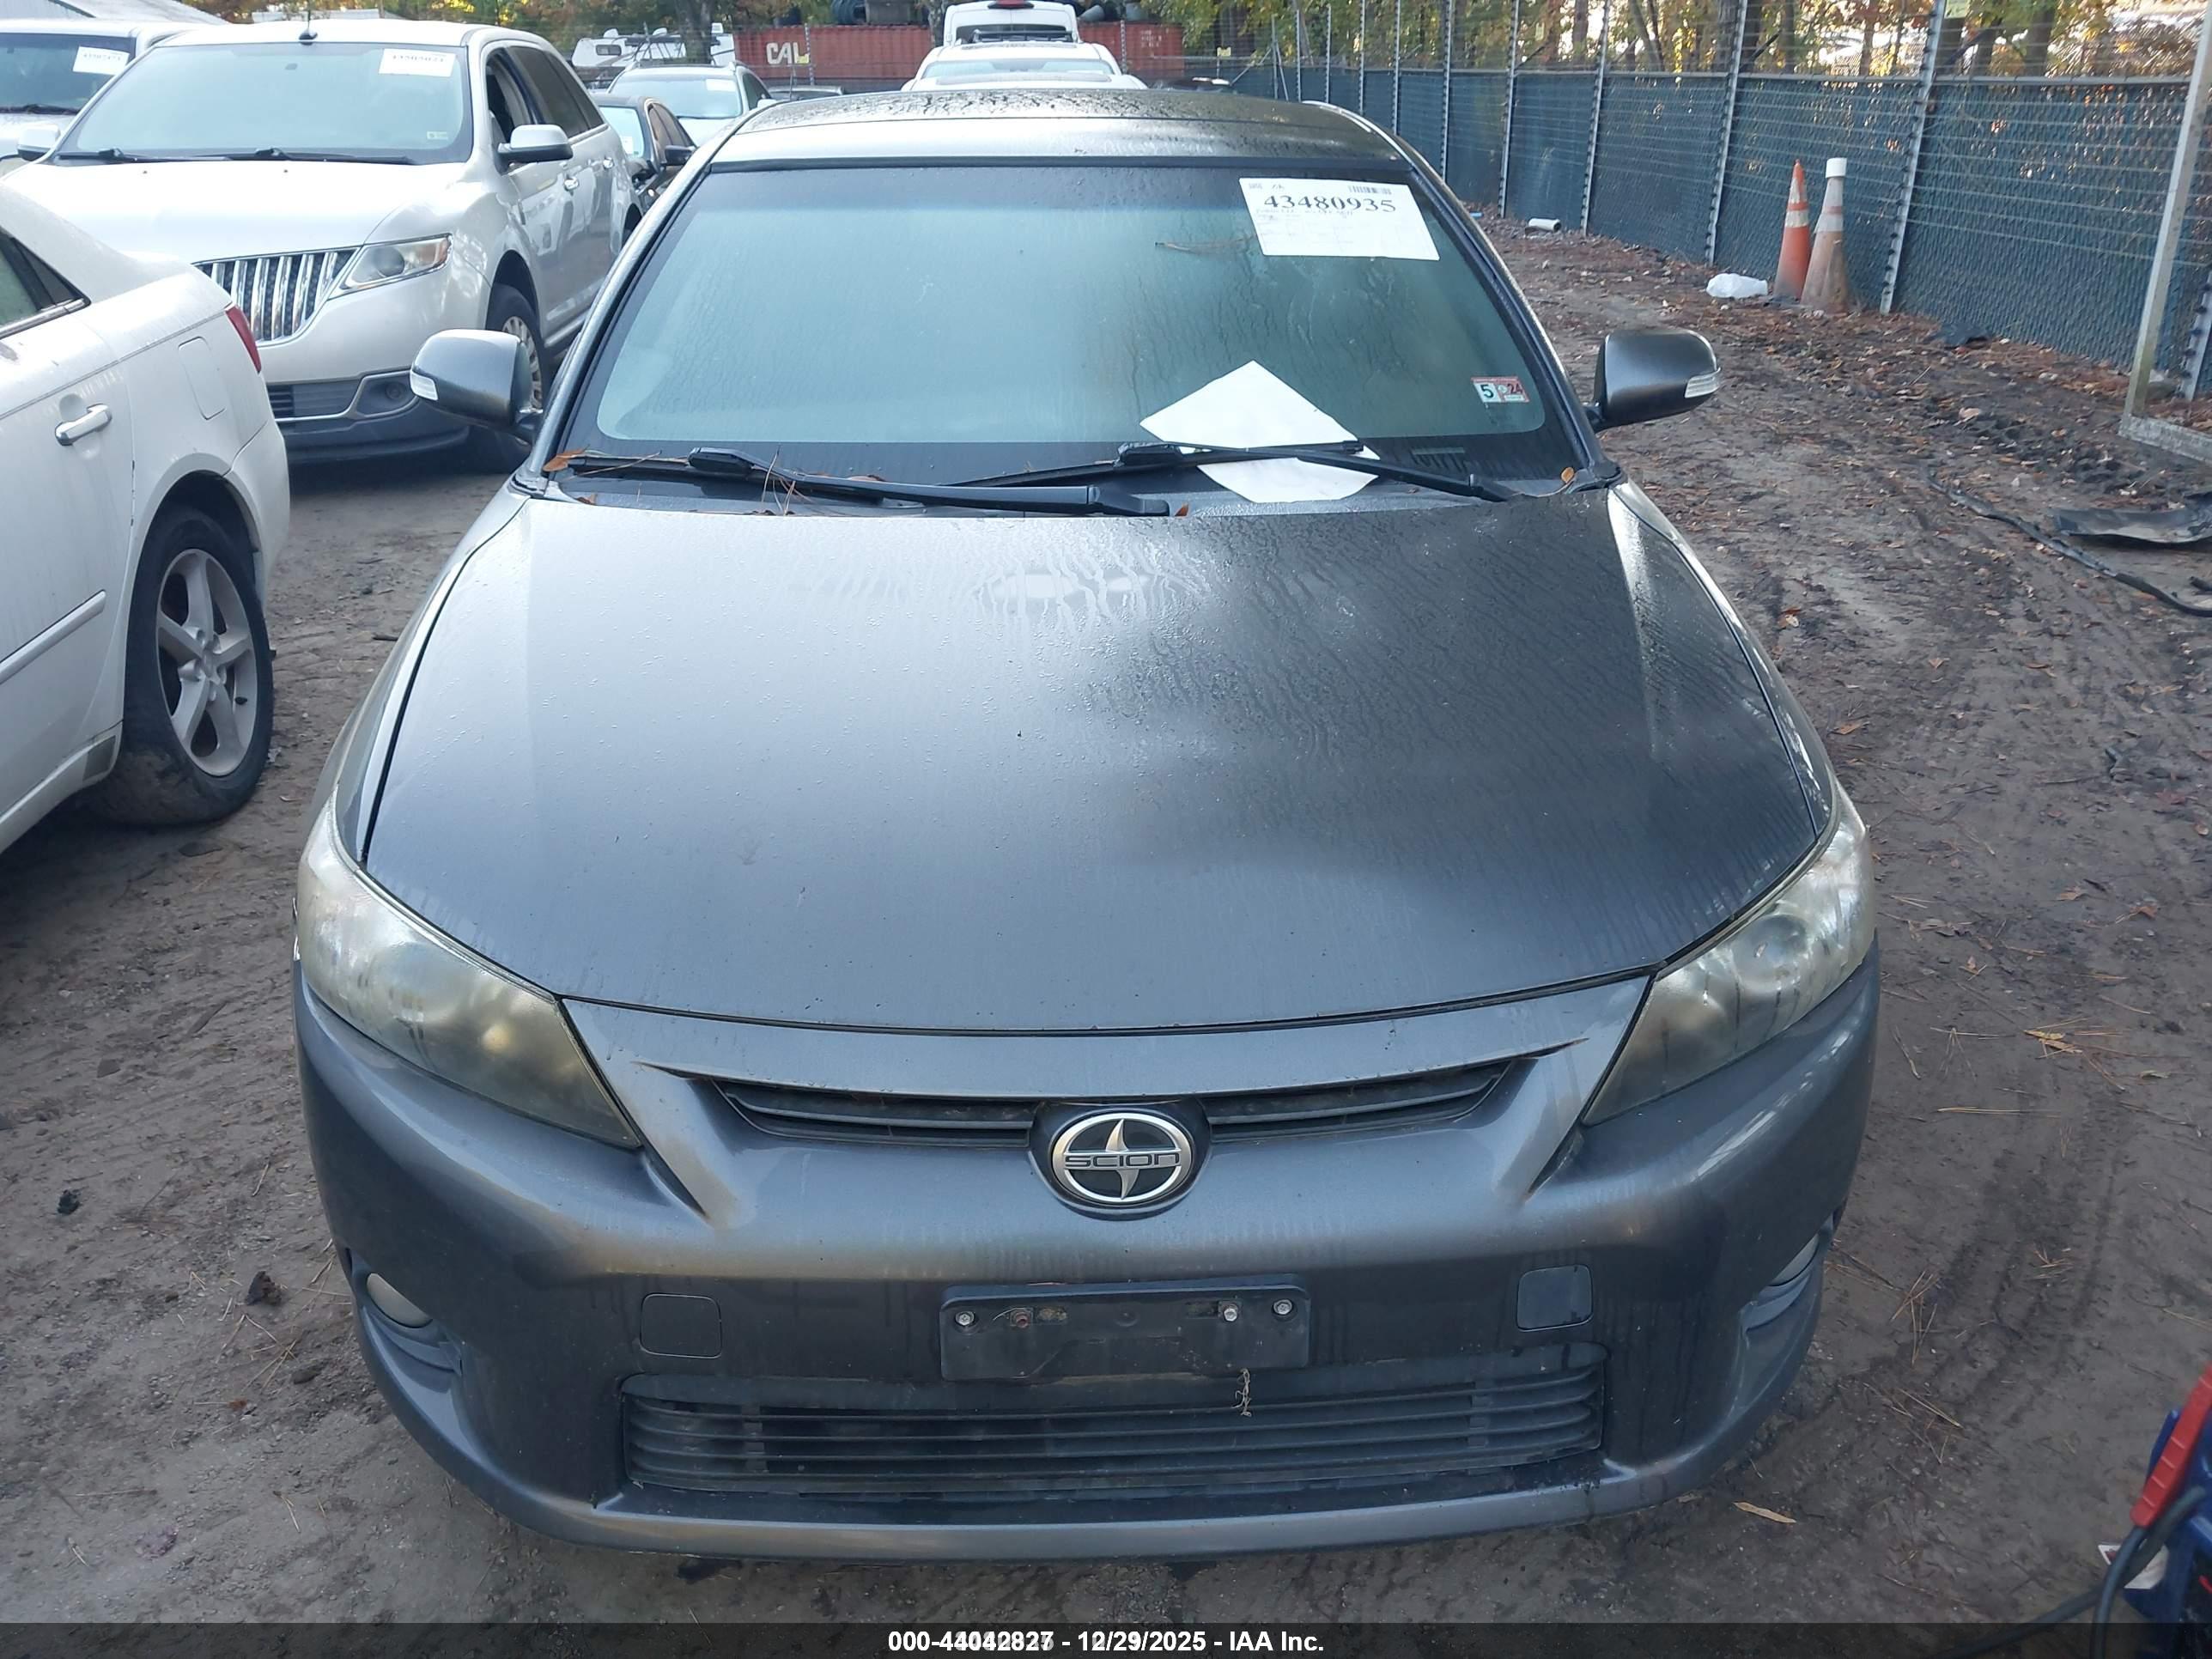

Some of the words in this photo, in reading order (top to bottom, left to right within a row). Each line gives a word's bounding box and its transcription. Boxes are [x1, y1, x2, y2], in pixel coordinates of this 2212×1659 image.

[1264, 195, 1396, 213] 43480935
[1480, 384, 1494, 398] 5
[1065, 1152, 1179, 1168] SCION
